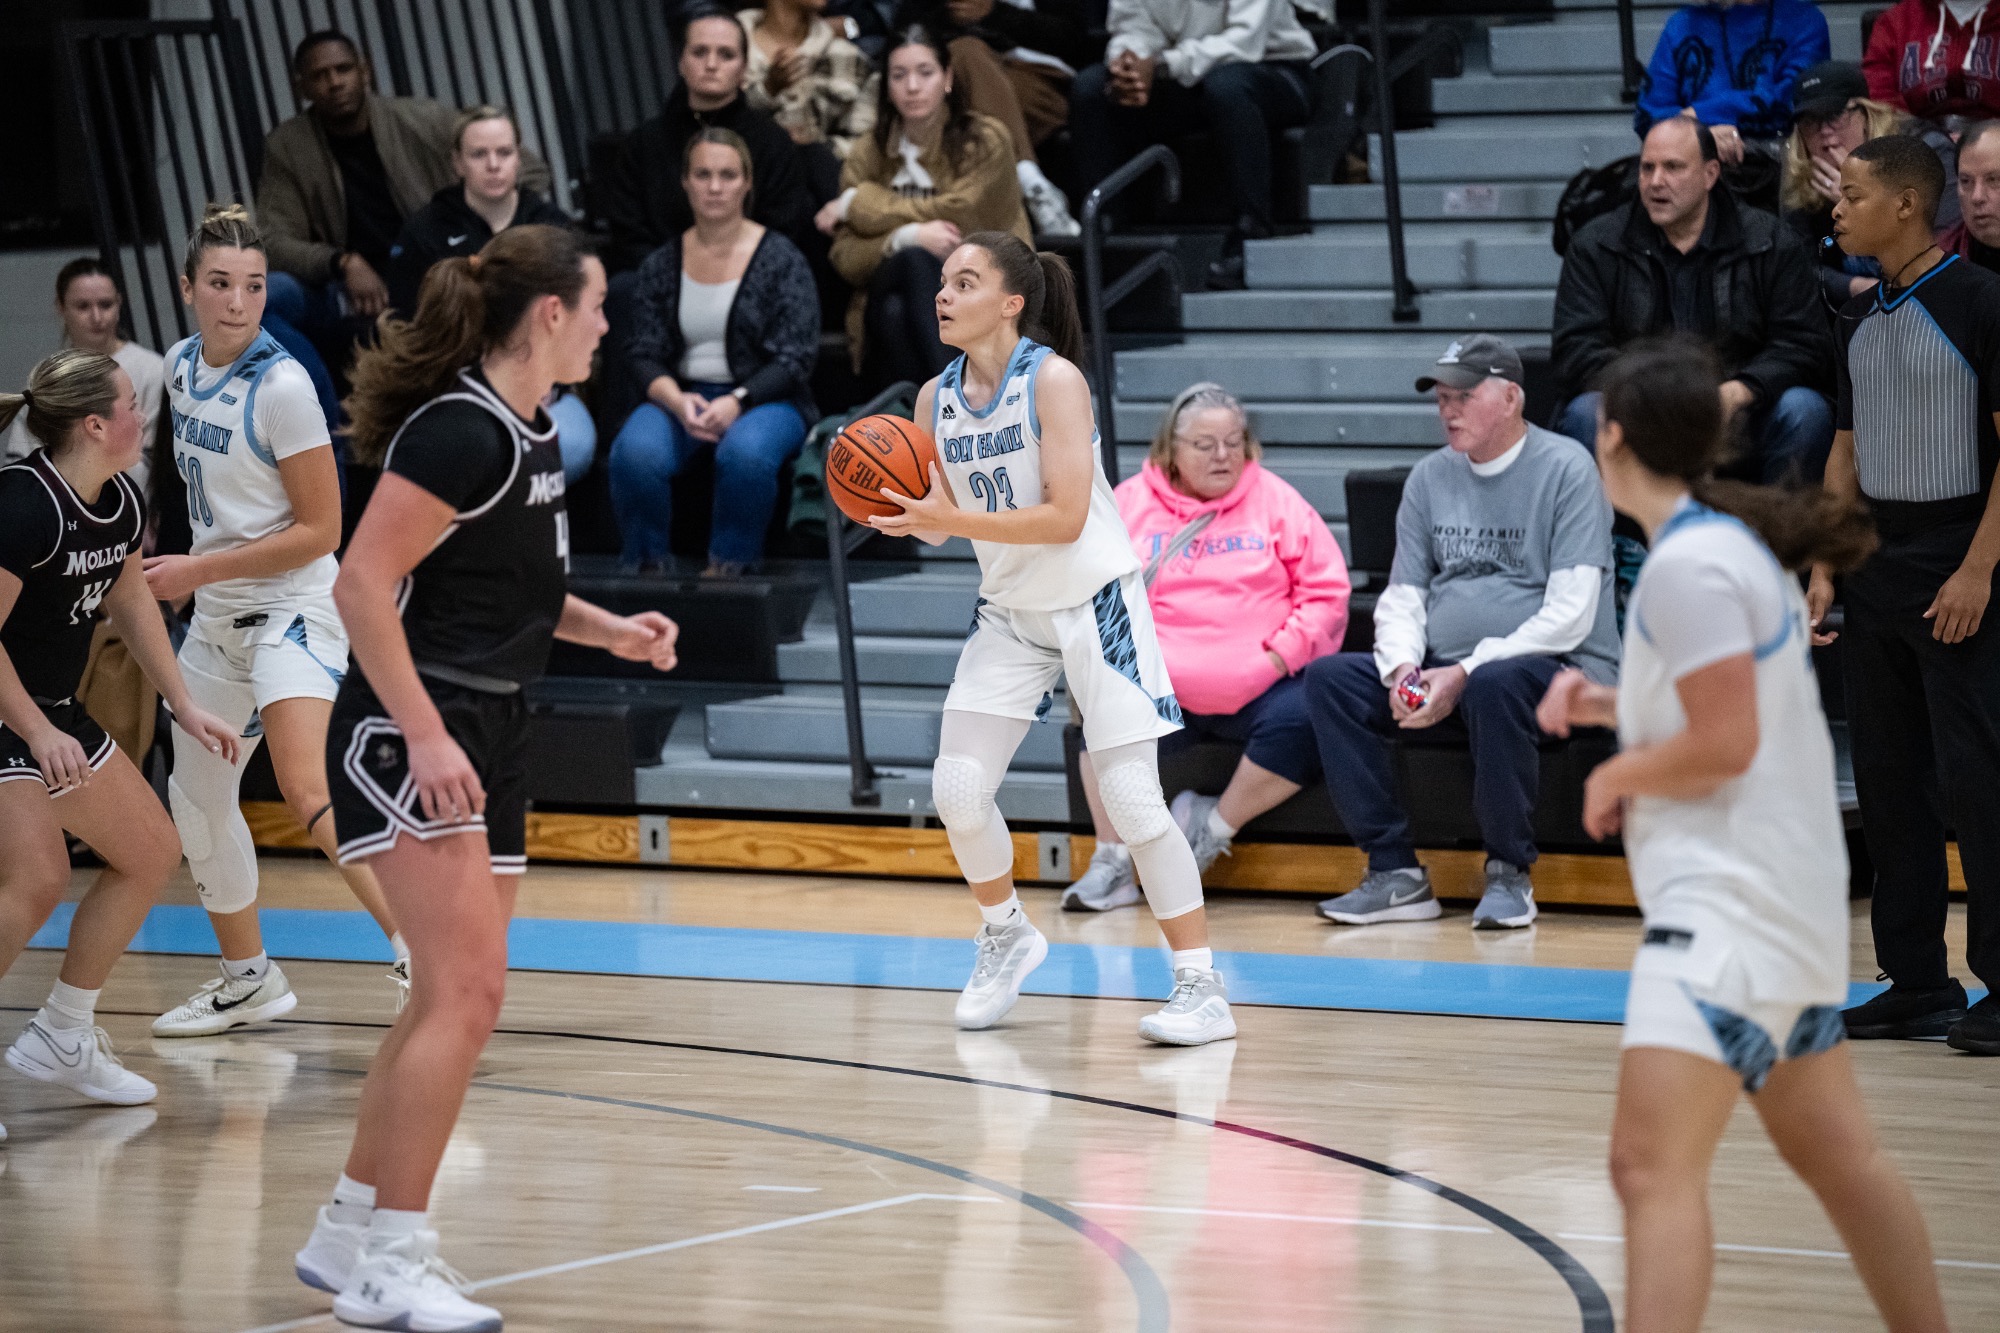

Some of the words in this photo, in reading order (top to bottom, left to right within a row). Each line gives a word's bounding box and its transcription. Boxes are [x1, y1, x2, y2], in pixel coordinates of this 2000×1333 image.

[1900, 34, 2000, 91] AER
[185, 415, 232, 455] FAMILY
[977, 422, 1025, 460] FAMILY
[831, 440, 854, 476] ROC
[849, 461, 885, 493] THE
[177, 451, 214, 528] 10
[969, 466, 1018, 513] 23
[1143, 531, 1265, 561] TGERS
[1433, 524, 1471, 537] HOLY
[61, 541, 128, 576] MOLLOY
[69, 577, 113, 625] 14
